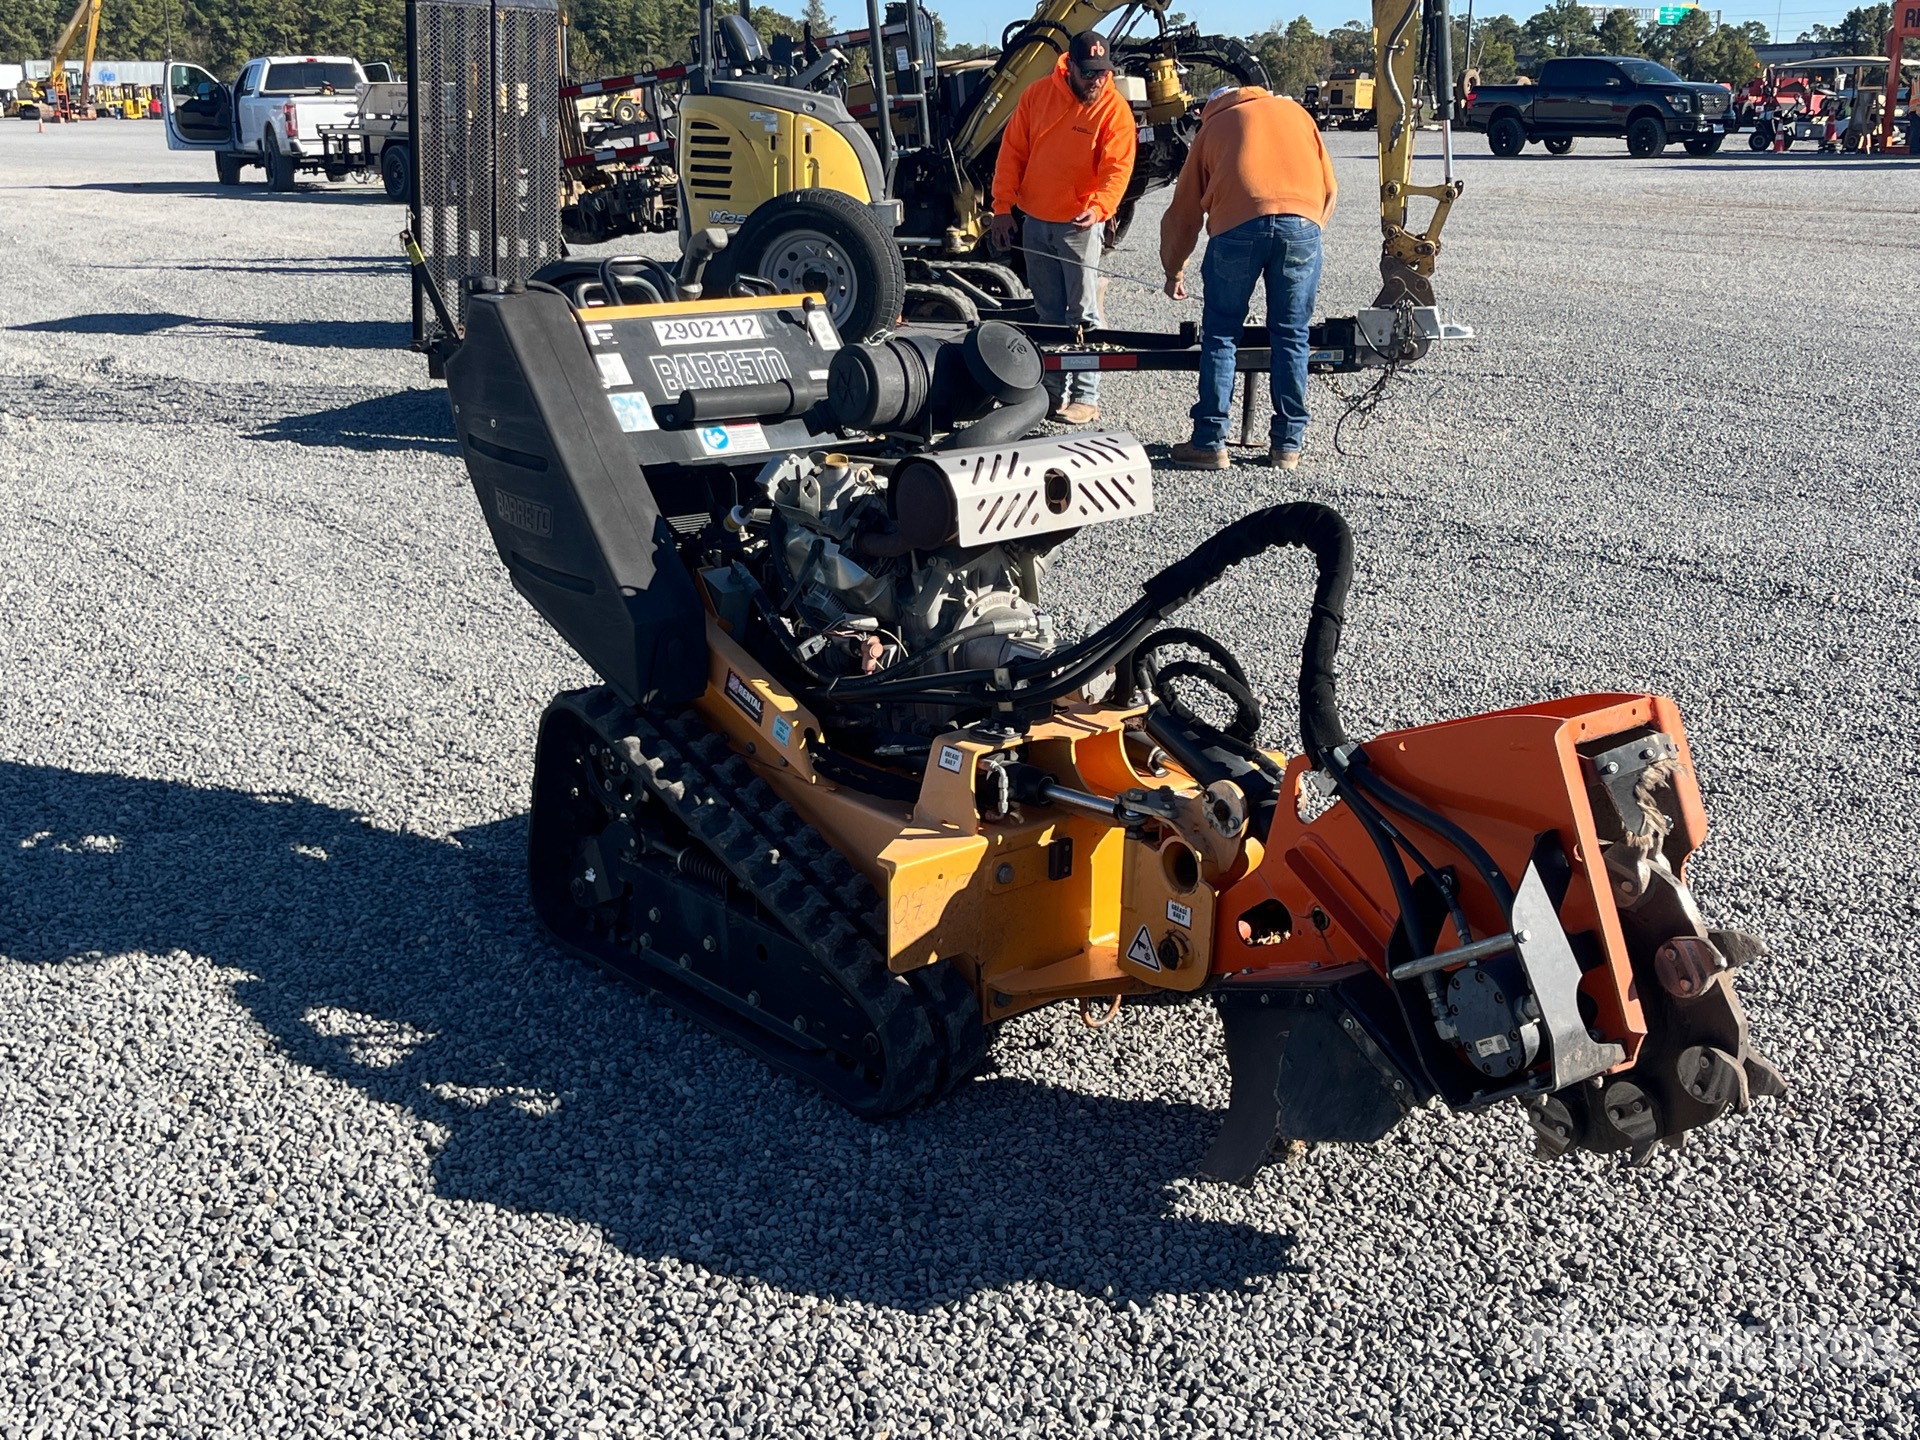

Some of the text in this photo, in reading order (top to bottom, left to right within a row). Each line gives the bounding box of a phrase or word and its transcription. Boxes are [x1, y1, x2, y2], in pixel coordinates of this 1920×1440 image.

[1090, 41, 1105, 56] rb
[649, 347, 792, 399] BARRETO
[495, 489, 552, 535] BARRETO
[738, 684, 762, 712] RENTAL
